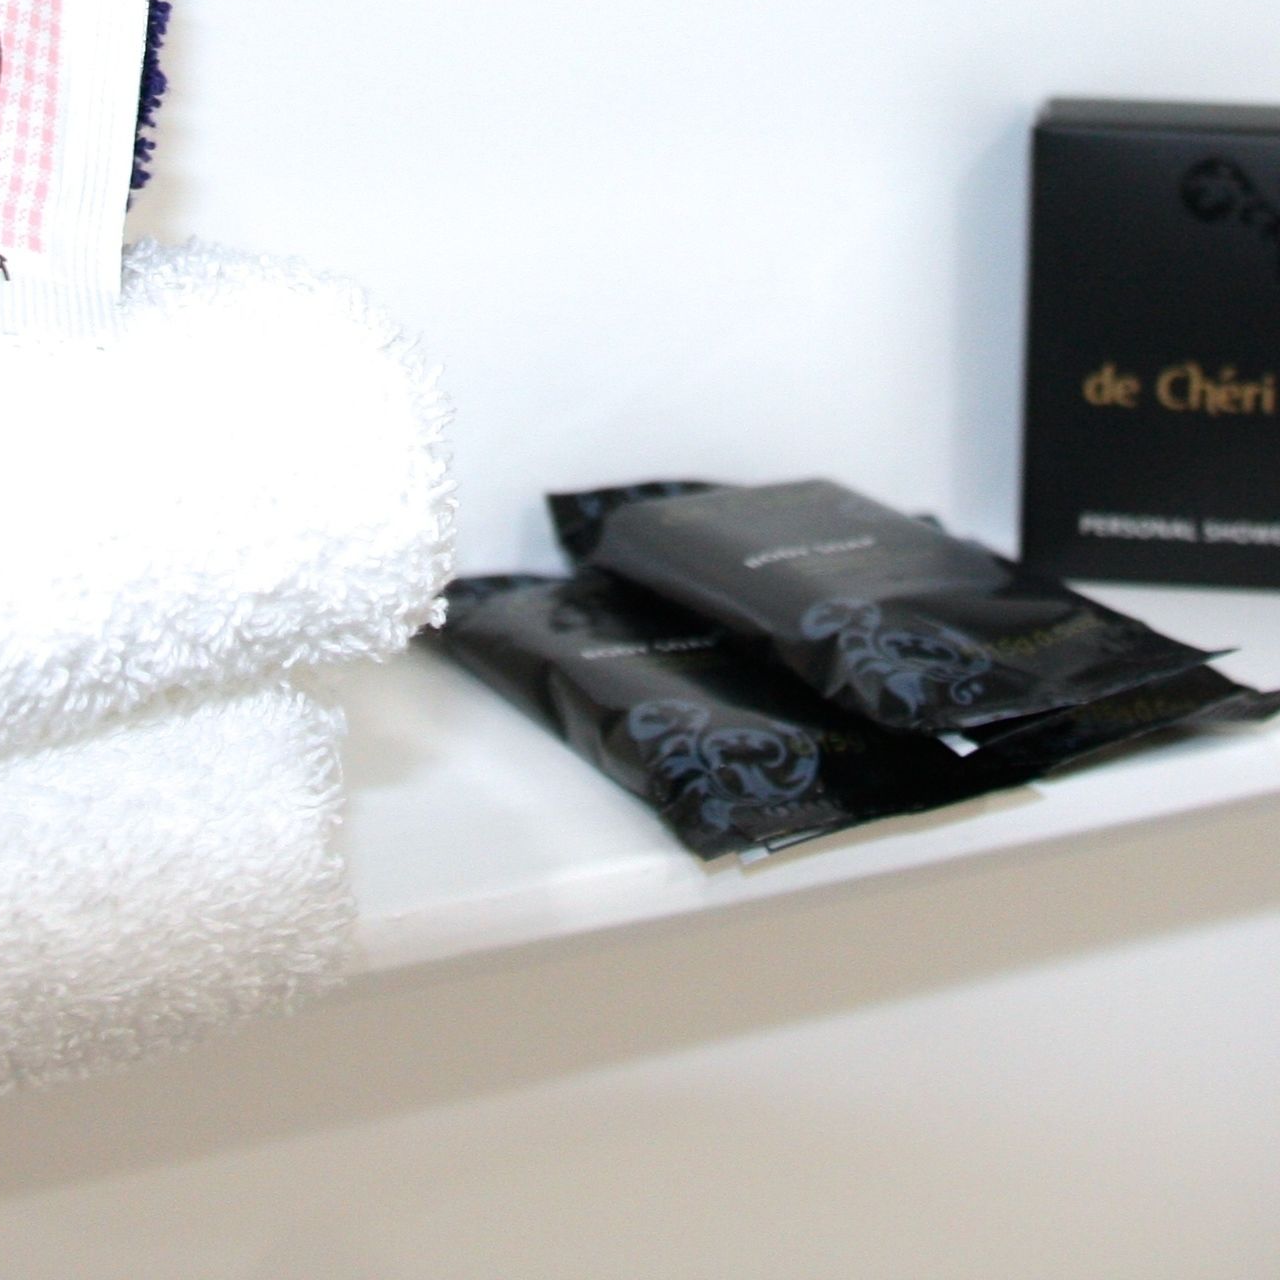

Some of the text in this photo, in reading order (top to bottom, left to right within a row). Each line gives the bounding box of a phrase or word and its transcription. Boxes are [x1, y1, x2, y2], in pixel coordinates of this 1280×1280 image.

[1081, 360, 1278, 416] de Chéri
[1078, 512, 1198, 543] PERSONAL
